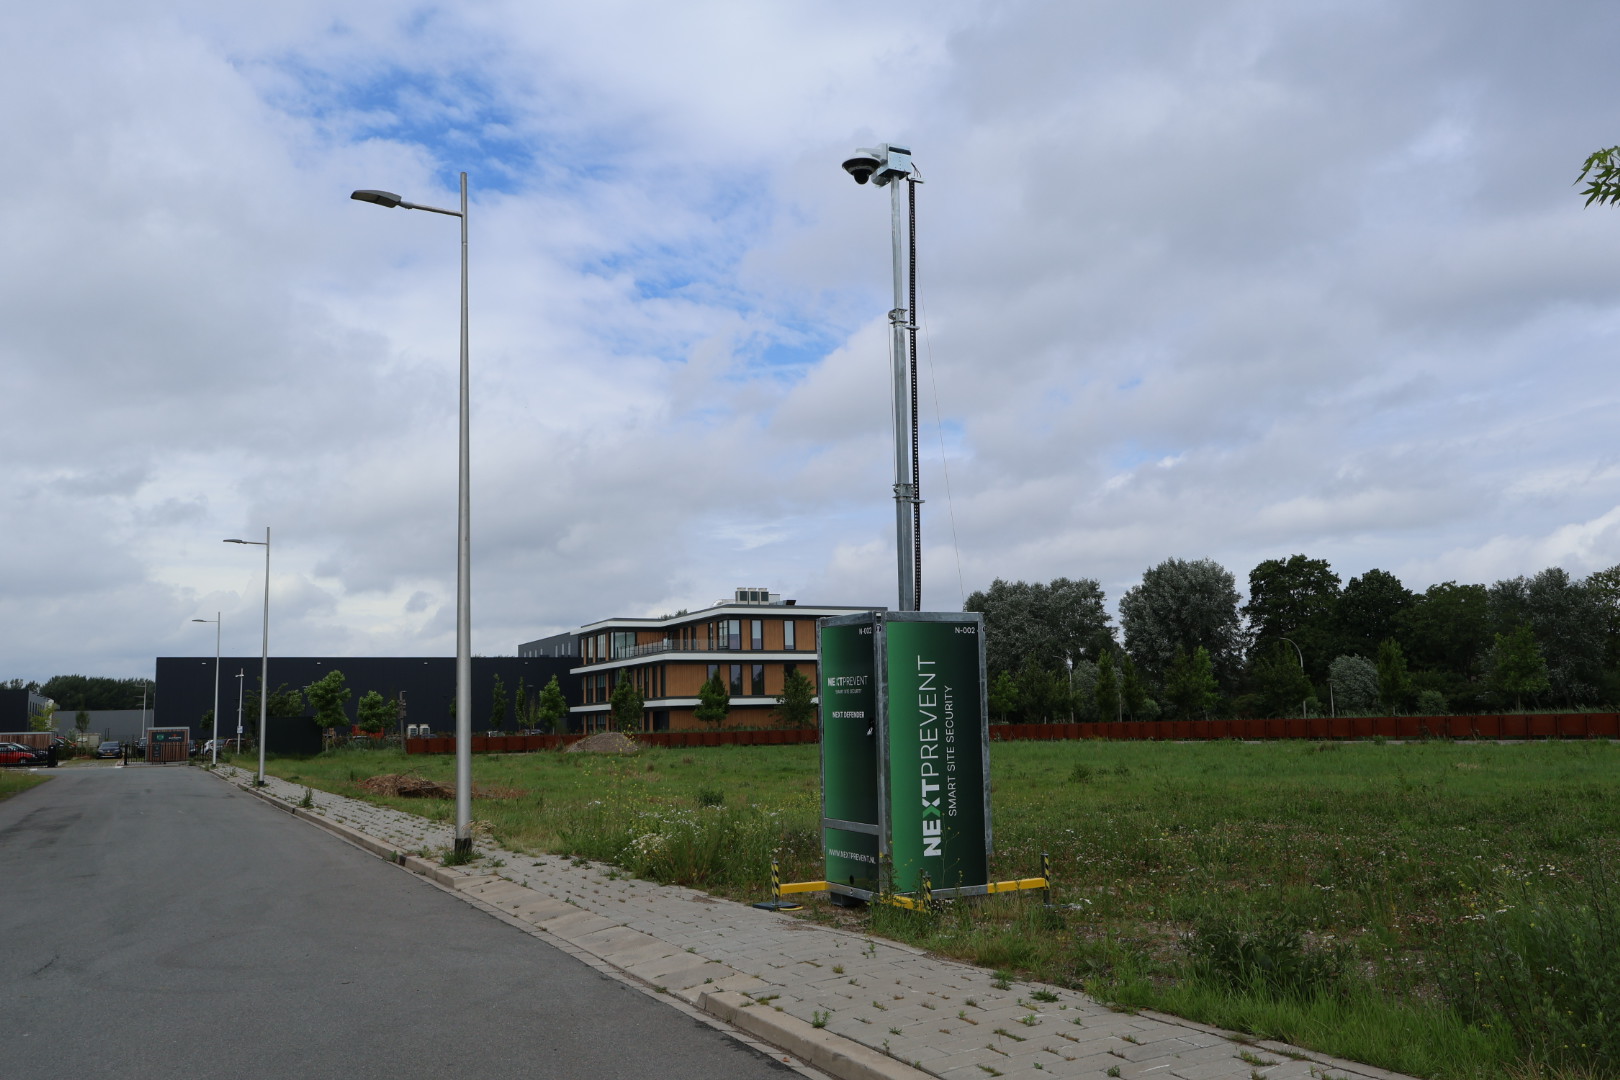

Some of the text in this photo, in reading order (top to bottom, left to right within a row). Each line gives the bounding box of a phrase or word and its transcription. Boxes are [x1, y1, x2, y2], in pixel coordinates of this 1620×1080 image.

[917, 655, 942, 856] NEXTPREVENT
[944, 685, 957, 816] SMART SITE SECURITY
